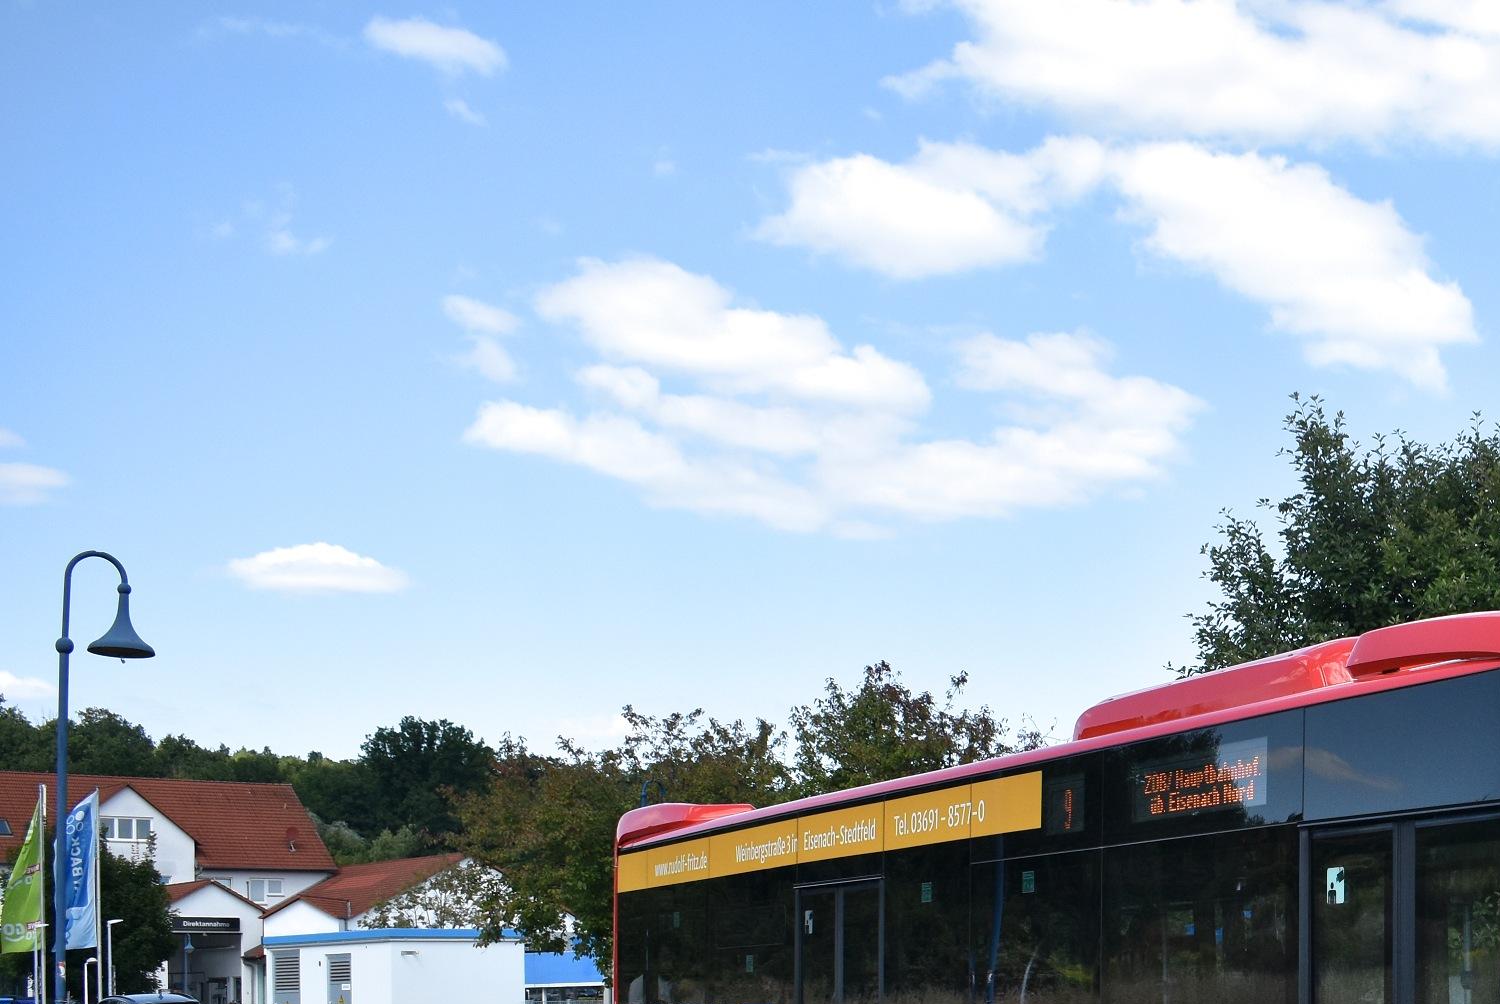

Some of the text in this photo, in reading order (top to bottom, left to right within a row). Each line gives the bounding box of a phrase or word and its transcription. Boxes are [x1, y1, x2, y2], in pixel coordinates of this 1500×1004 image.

[1169, 786, 1220, 812] Eisenach
[1223, 779, 1255, 804] Nord
[894, 815, 909, 836] Tel.
[911, 808, 939, 833] 03691
[654, 855, 708, 877] www.rudolf-fritz.de
[735, 837, 785, 864] Weinbergstraße
[786, 836, 791, 854] 3
[803, 818, 876, 850] Eisenach-Stedtfeld
